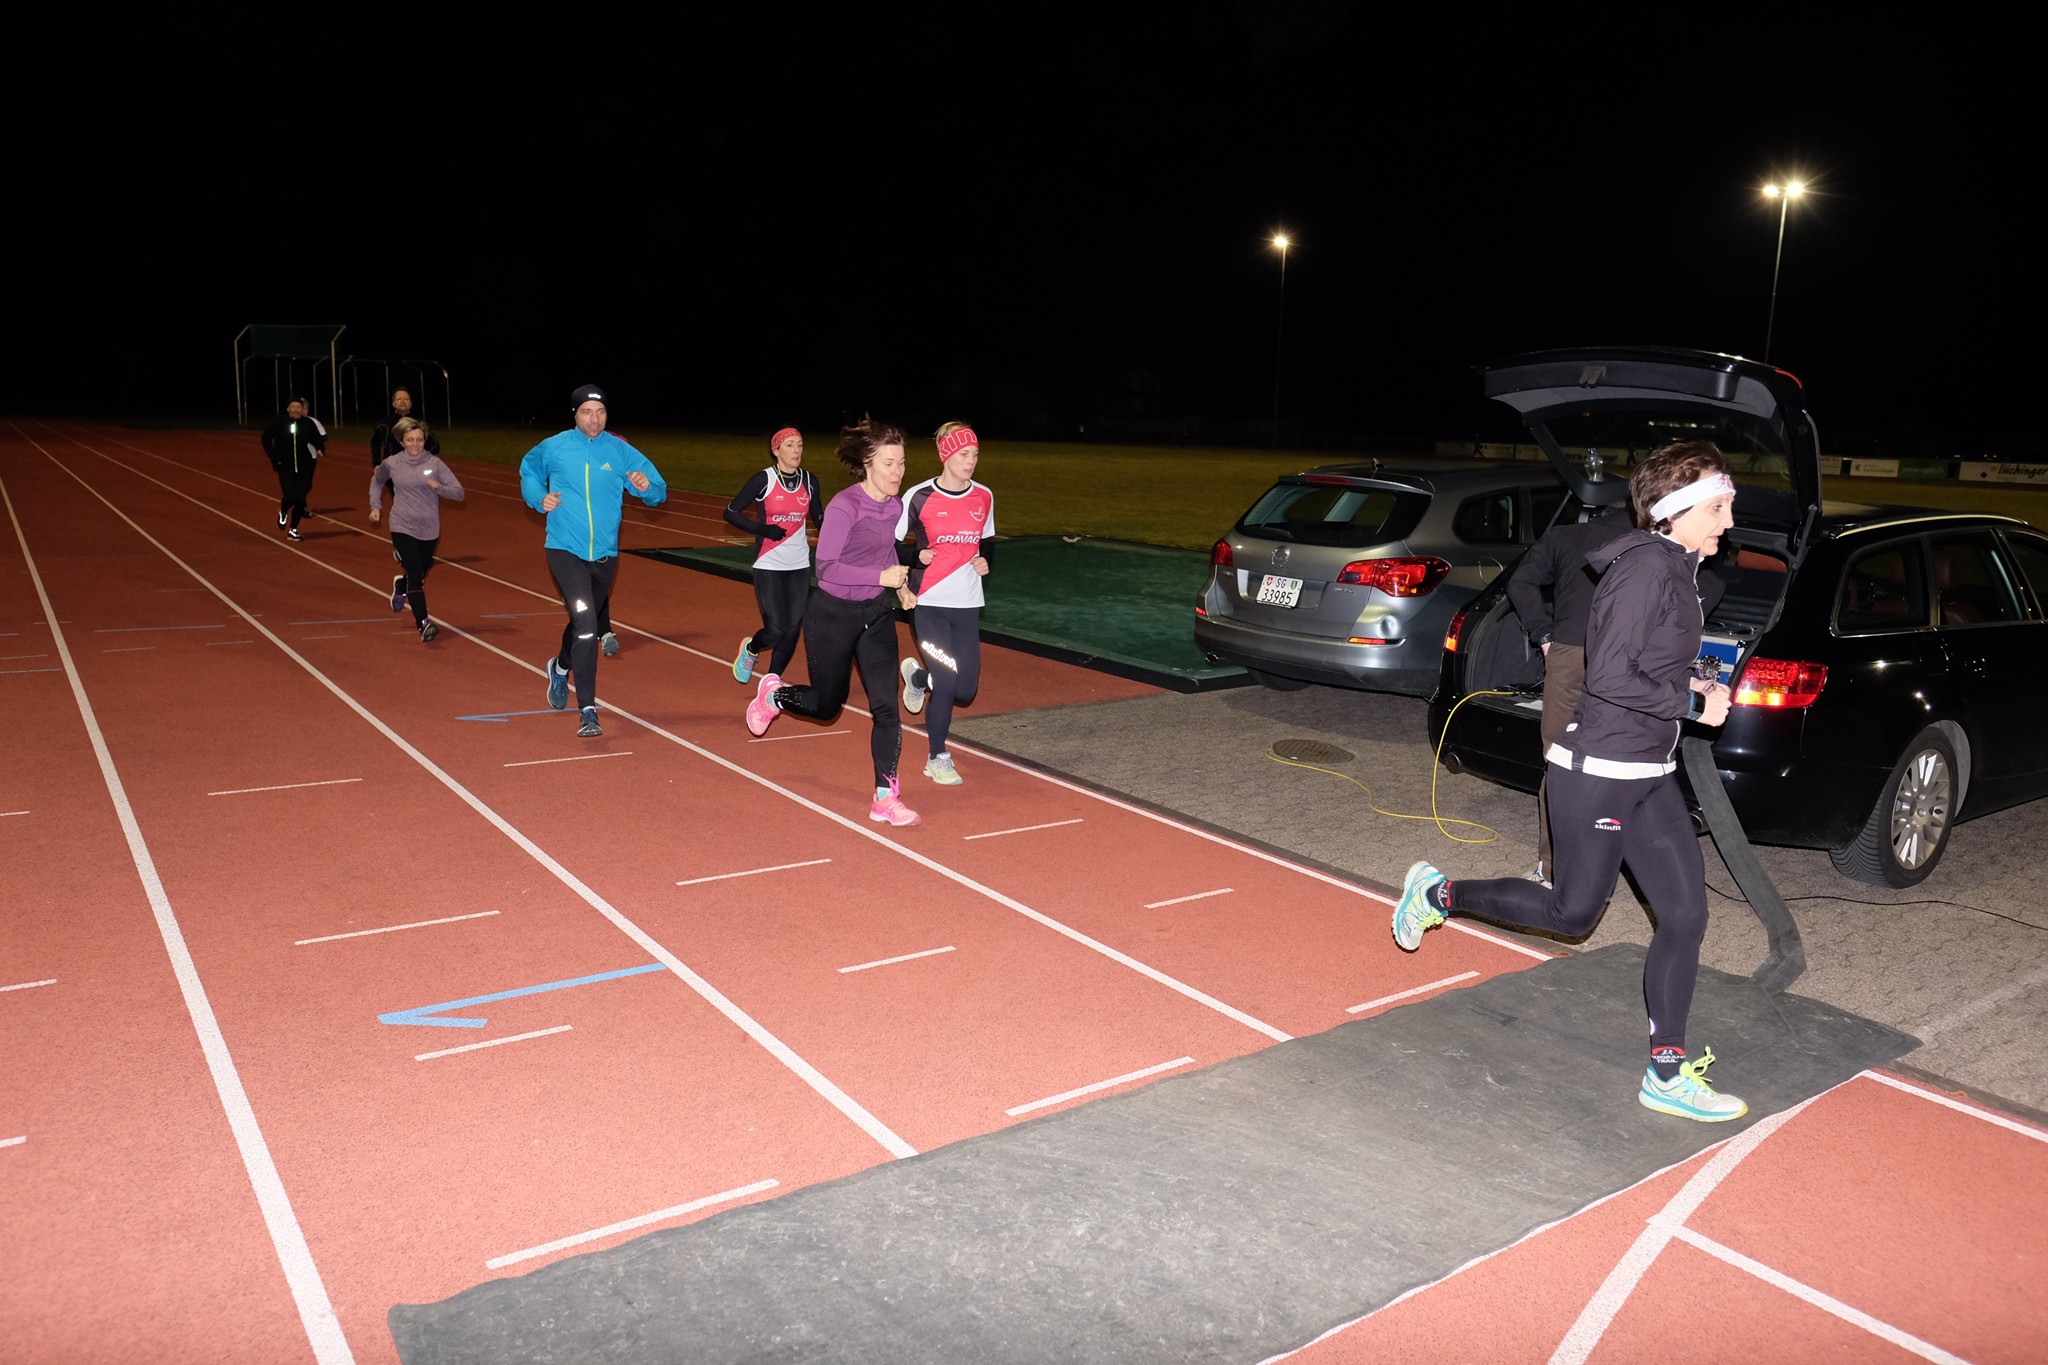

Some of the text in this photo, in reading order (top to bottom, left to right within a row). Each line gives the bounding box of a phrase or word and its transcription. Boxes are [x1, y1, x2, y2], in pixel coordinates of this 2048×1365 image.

[936, 535, 980, 545] GRAVAG
[1275, 577, 1287, 589] SG
[1261, 588, 1293, 605] 33985
[1594, 823, 1622, 831] skinfit
